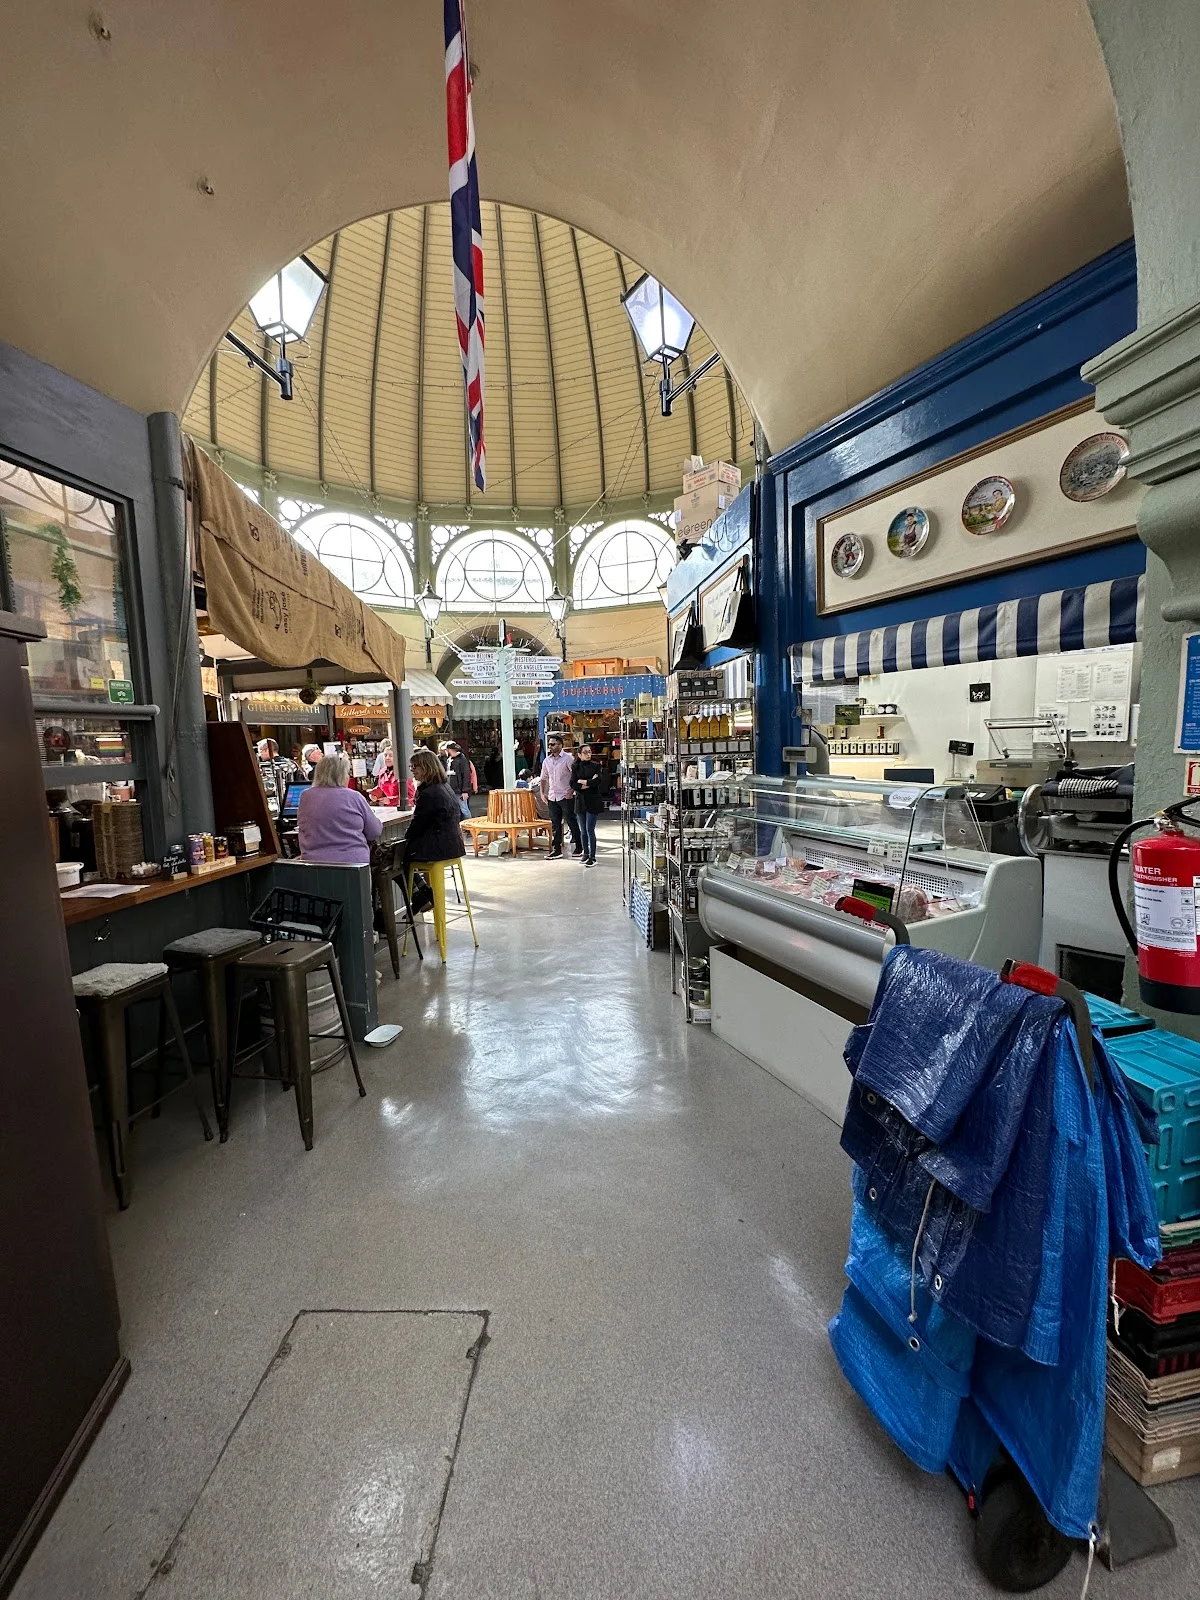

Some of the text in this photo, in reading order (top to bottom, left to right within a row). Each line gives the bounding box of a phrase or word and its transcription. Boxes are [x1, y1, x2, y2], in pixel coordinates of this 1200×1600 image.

[562, 685, 624, 697] DUFFLEBAG
[247, 703, 291, 713] GILLARDS
[300, 705, 321, 714] BATH
[892, 794, 913, 802] Google
[1134, 864, 1162, 876] WATER
[1133, 872, 1178, 883] EXTINGUISHER
